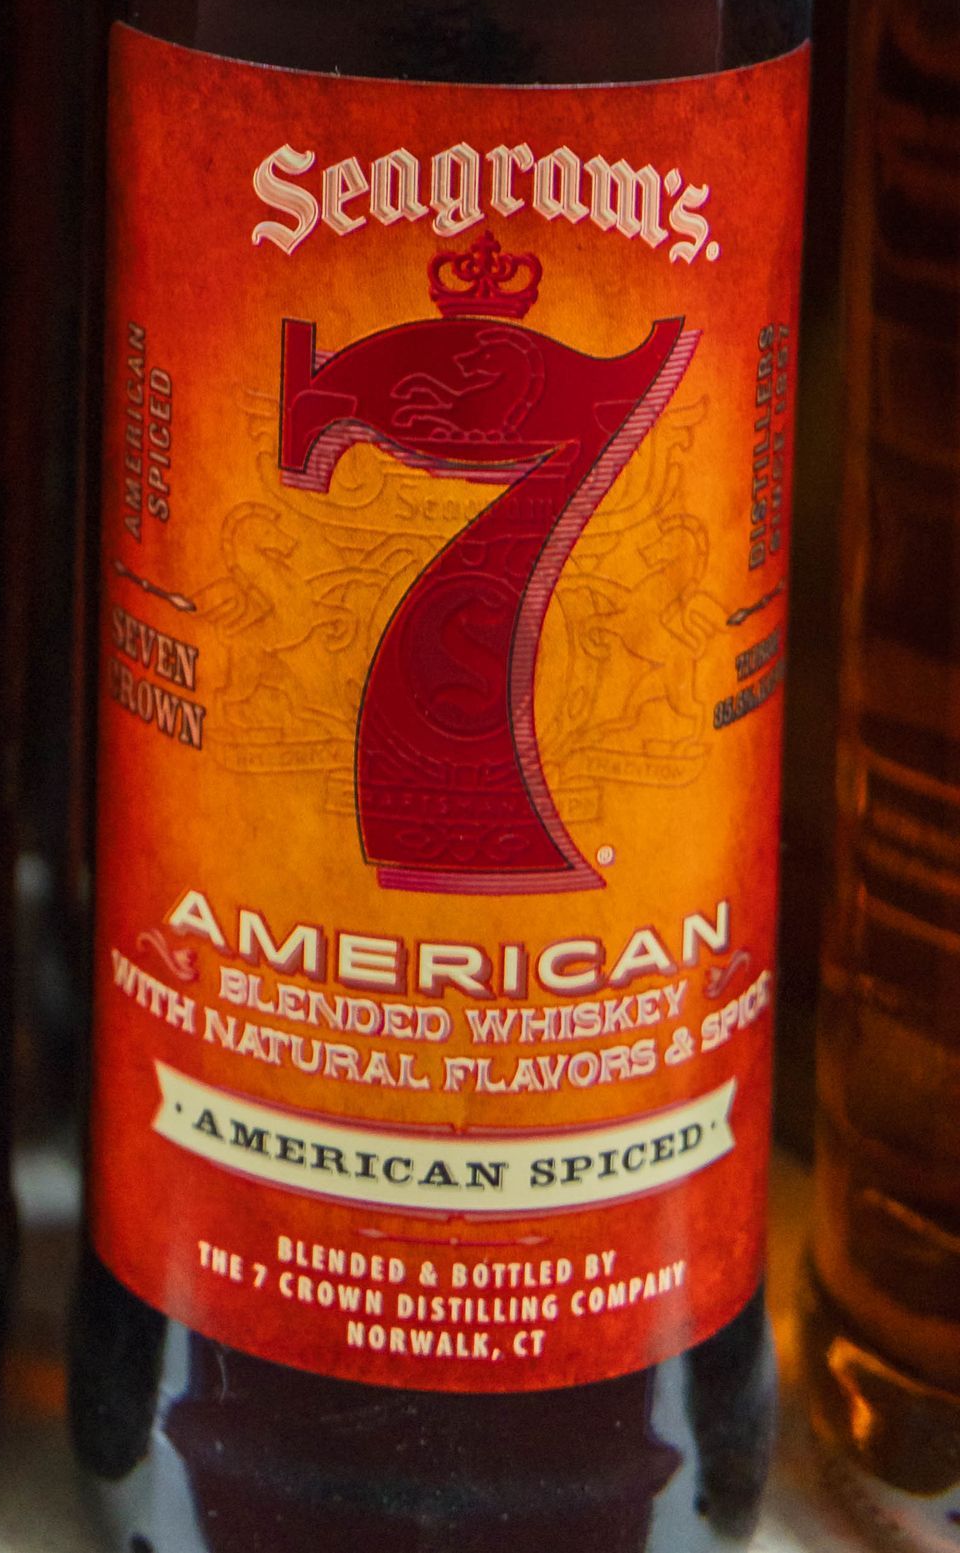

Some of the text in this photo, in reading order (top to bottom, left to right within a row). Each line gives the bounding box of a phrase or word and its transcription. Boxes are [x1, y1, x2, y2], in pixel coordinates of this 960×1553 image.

[123, 321, 146, 545] AMERICAN
[147, 365, 173, 524] SPICED
[278, 315, 704, 896] 7
[169, 888, 732, 1000] AMERICAN
[111, 948, 196, 1035] WITH
[202, 1007, 431, 1092] NATURAL
[443, 1039, 657, 1095] FLAVORS
[664, 1026, 696, 1068] &
[219, 965, 689, 1045] BLENDED WHISKEY
[192, 1105, 703, 1189] AMERICAN SPICED
[198, 1240, 687, 1324] THE 7 CROWN DISTILLING COMPANY
[277, 1235, 617, 1290] BLENDED & BOTTLED BY
[512, 1330, 547, 1358] CT
